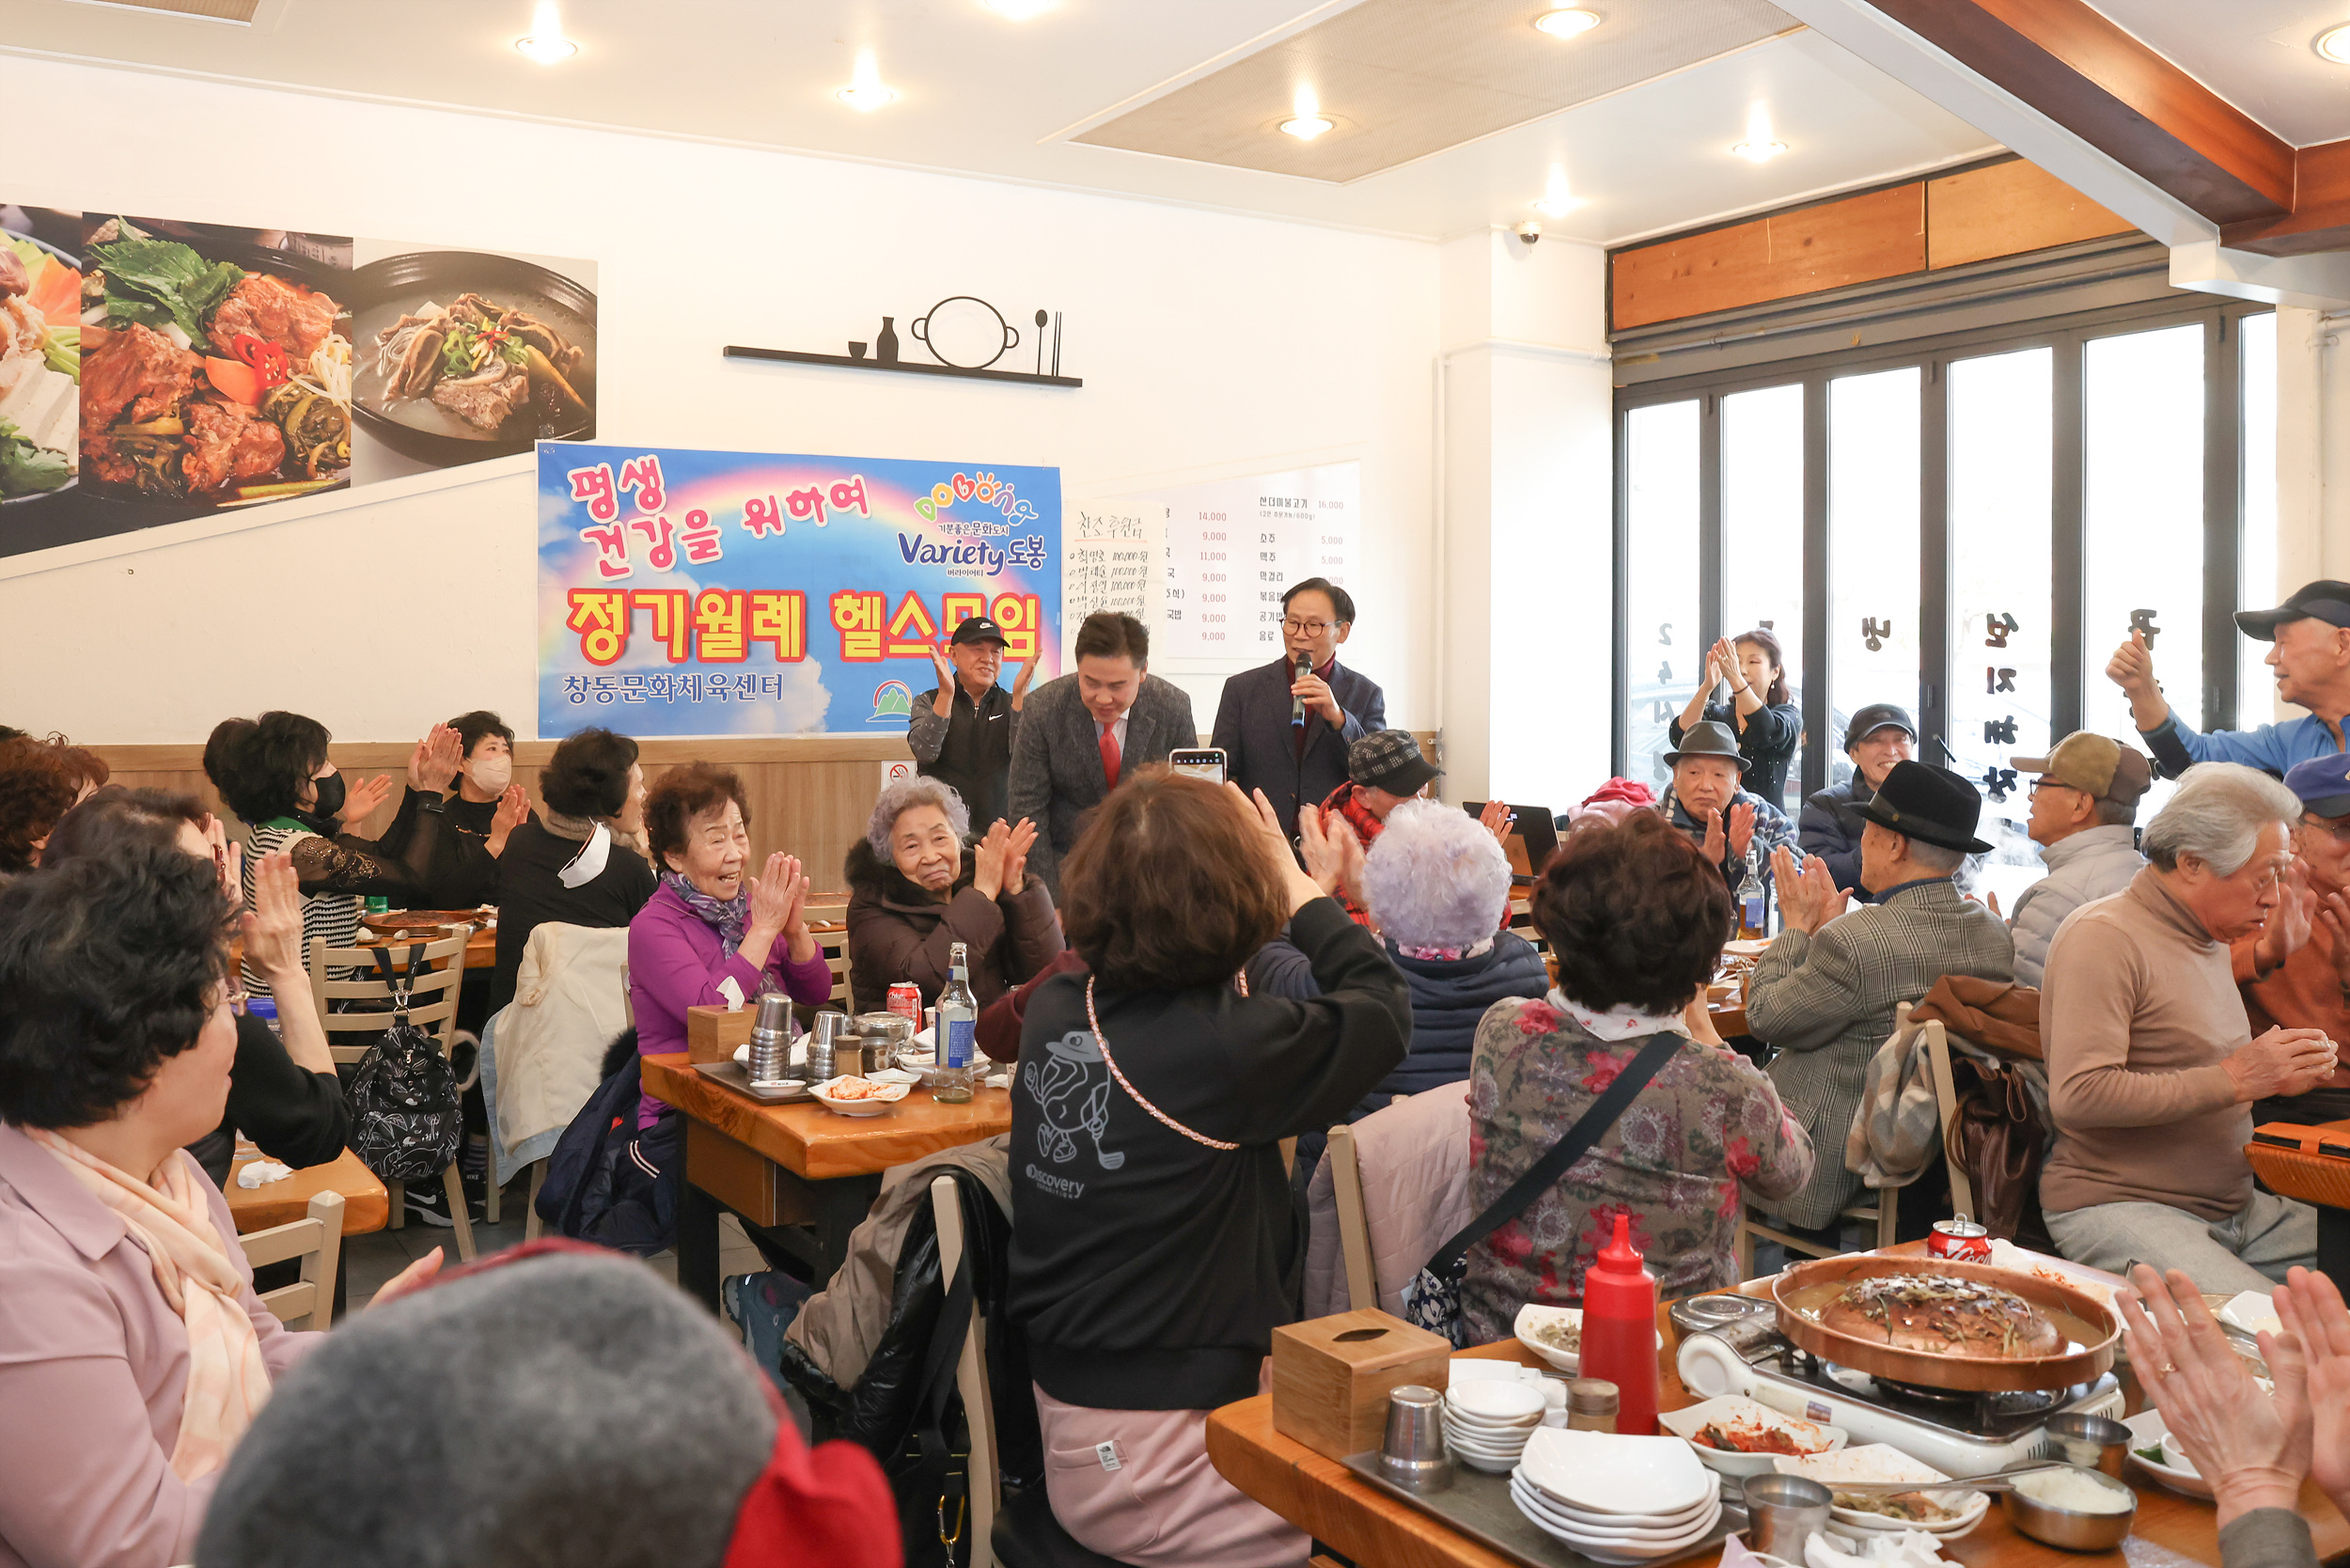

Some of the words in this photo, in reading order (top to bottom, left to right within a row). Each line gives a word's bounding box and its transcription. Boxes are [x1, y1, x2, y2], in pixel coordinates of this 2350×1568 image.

[569, 456, 666, 523] 평생
[581, 508, 722, 580] 건강을
[742, 475, 870, 538] 위하여
[1261, 533, 1276, 543] 소주
[898, 533, 1004, 576] Variety
[1008, 536, 1046, 569] 도봉
[1260, 552, 1277, 562] 맥주
[1260, 571, 1283, 582] 막걸리
[567, 588, 806, 666] 정기월례
[1260, 631, 1275, 641] 음료
[563, 672, 783, 704] 창동문화체육센터
